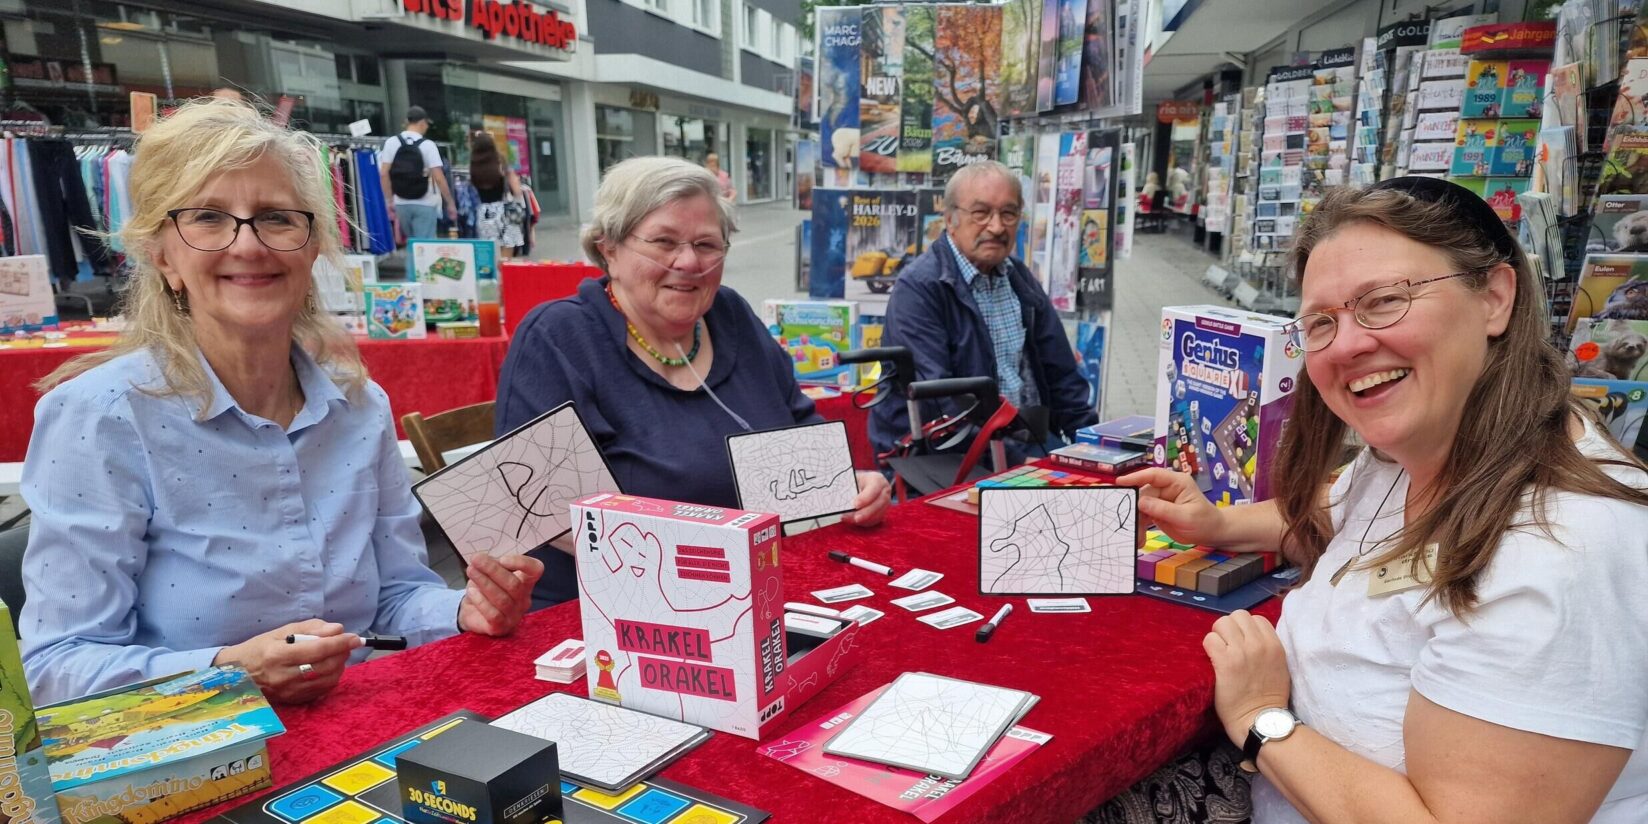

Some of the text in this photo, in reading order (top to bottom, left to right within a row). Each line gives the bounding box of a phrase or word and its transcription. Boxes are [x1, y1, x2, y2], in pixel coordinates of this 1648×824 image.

[471, 0, 576, 49] Apotheke
[825, 24, 857, 35] MARC
[867, 77, 896, 95] NEW
[1474, 93, 1496, 102] 1989
[853, 205, 918, 216] HARLEY-D
[853, 216, 880, 226] 2026
[1605, 201, 1625, 209] Otter
[1594, 265, 1614, 273] Eulen
[1182, 332, 1239, 371] Genius
[1183, 362, 1230, 388] SQUARE
[1229, 370, 1248, 399] XL
[587, 511, 598, 552] TOPP
[620, 622, 709, 660] KRAKEL
[772, 619, 783, 672] ORAKEL
[643, 662, 733, 697] ORAKEL
[762, 637, 774, 693] KRAKEL
[761, 700, 783, 722] TOPP
[1009, 729, 1043, 740] OPP
[63, 776, 202, 824] Kingdomino
[408, 787, 423, 804] 30
[424, 793, 477, 821] SECONDS
